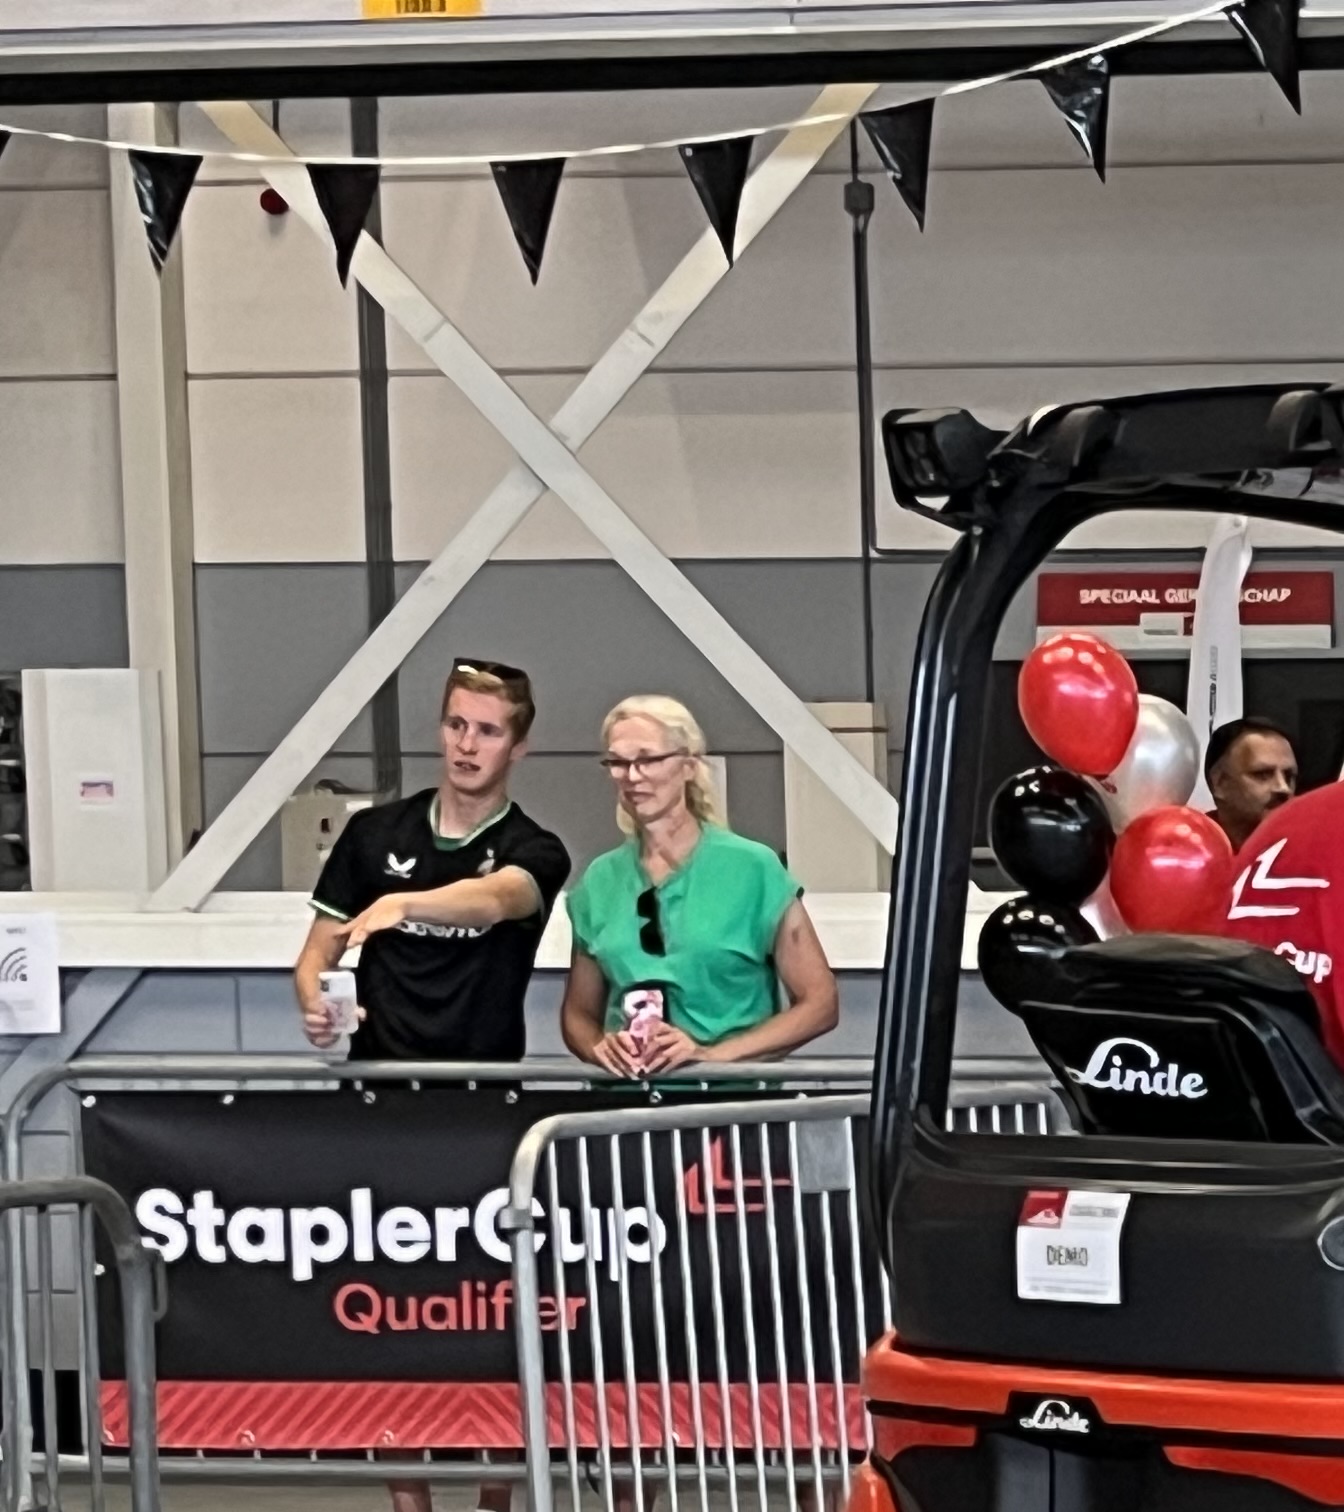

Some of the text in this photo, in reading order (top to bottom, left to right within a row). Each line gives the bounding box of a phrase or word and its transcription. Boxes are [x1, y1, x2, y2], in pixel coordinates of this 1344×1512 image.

[1065, 1037, 1209, 1098] Linde
[136, 1187, 668, 1281] StaplerCup
[333, 1278, 587, 1334] Qualifer
[1019, 1400, 1090, 1433] Linde
